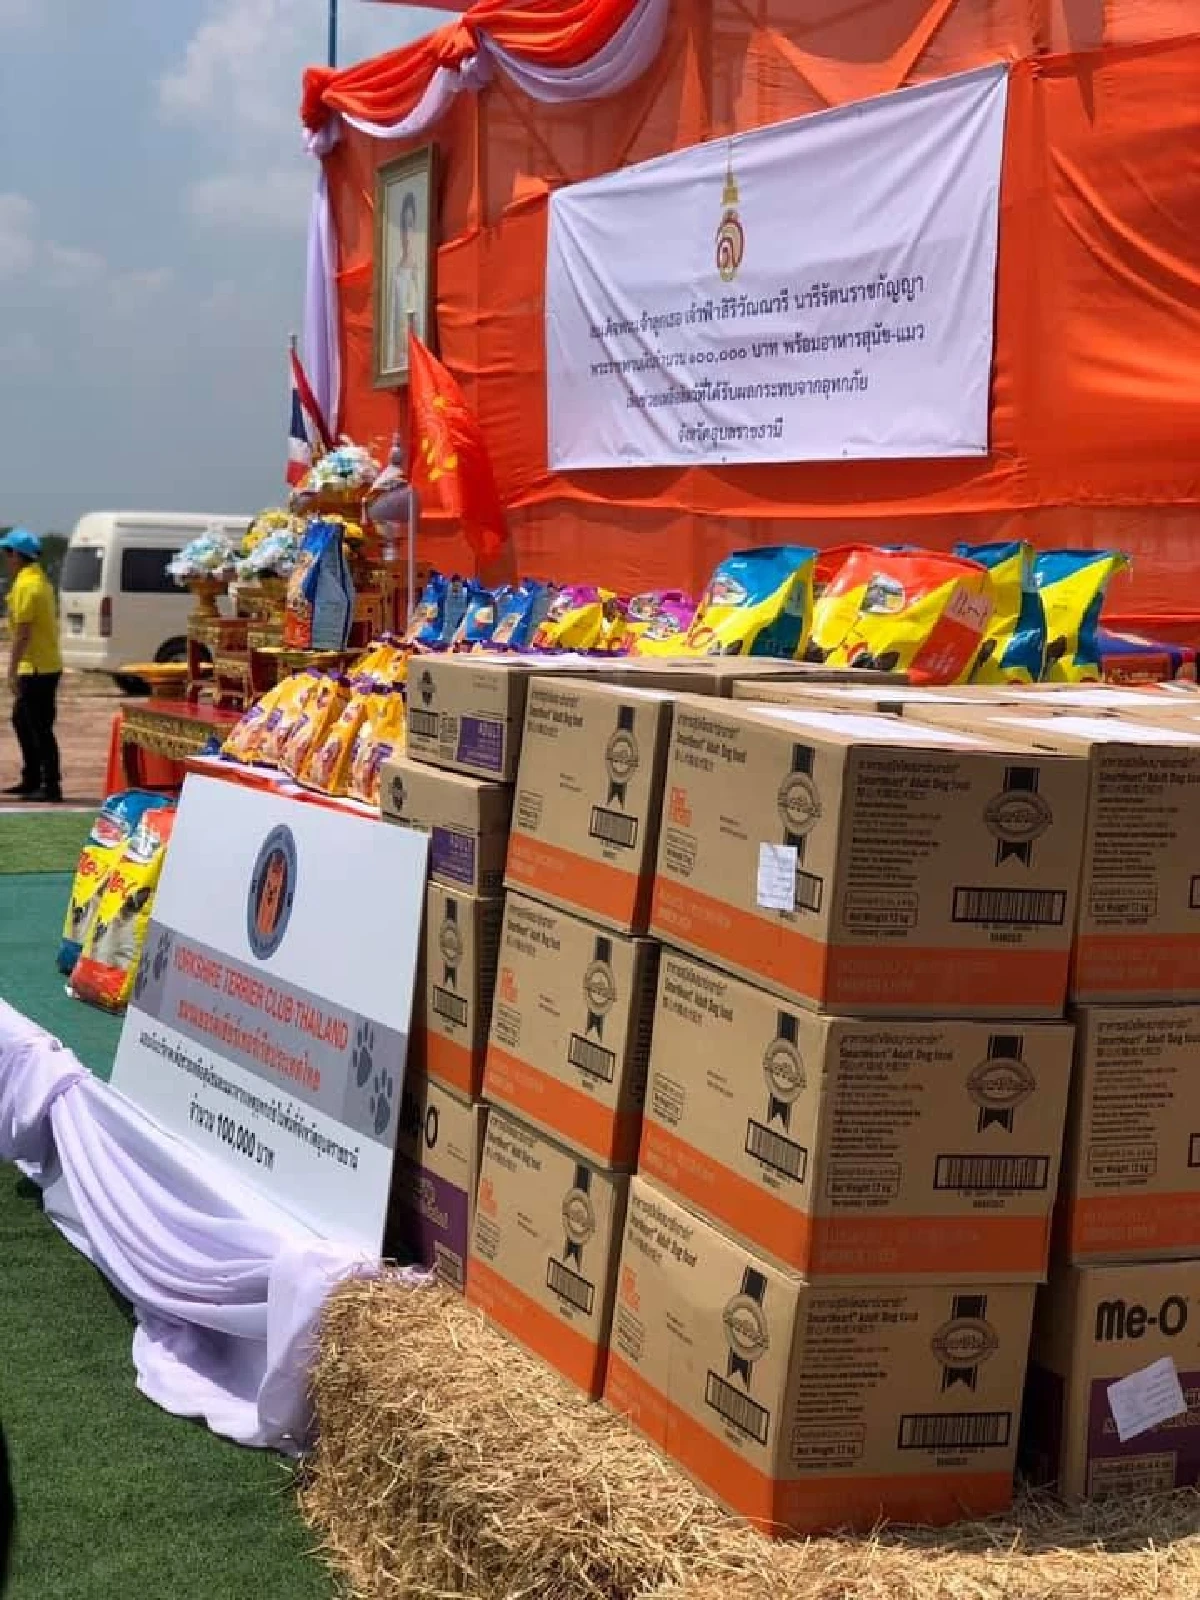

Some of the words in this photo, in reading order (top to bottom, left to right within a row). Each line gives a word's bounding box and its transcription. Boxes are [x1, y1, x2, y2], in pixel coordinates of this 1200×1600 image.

[751, 341, 779, 358] บาท
[223, 966, 265, 1008] TERRIER
[265, 987, 294, 1024] CLUB
[294, 1000, 349, 1051] THAILAND
[216, 1112, 256, 1158] 100,000
[1094, 1296, 1188, 1342] Me-O
